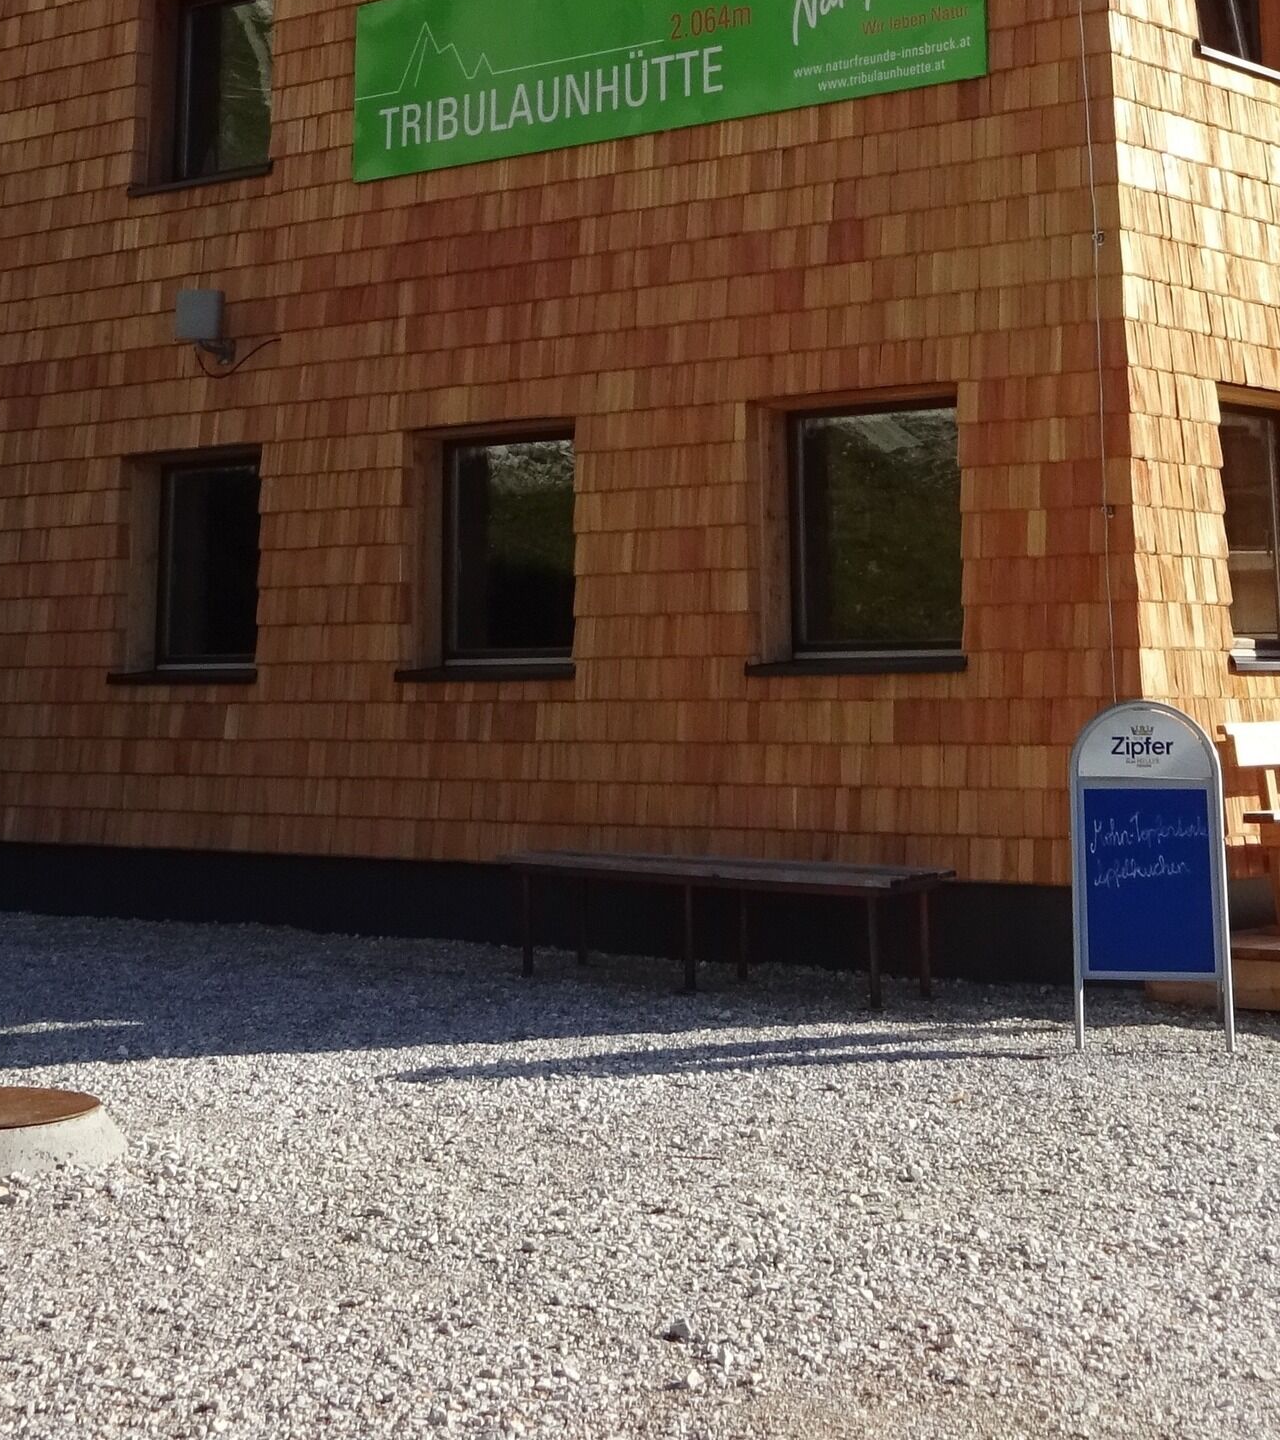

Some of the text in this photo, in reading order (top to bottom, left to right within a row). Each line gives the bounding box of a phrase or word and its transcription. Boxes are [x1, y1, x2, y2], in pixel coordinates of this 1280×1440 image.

[671, 5, 752, 40] 2.064m
[862, 5, 969, 35] Wir leben Natur
[793, 36, 972, 79] www.naturfreunde-innsbruck.at
[818, 60, 946, 92] www.tribulaunhuette.at
[379, 46, 723, 150] TRIBULAUNHÜTTE
[1111, 736, 1174, 758] Zipfer
